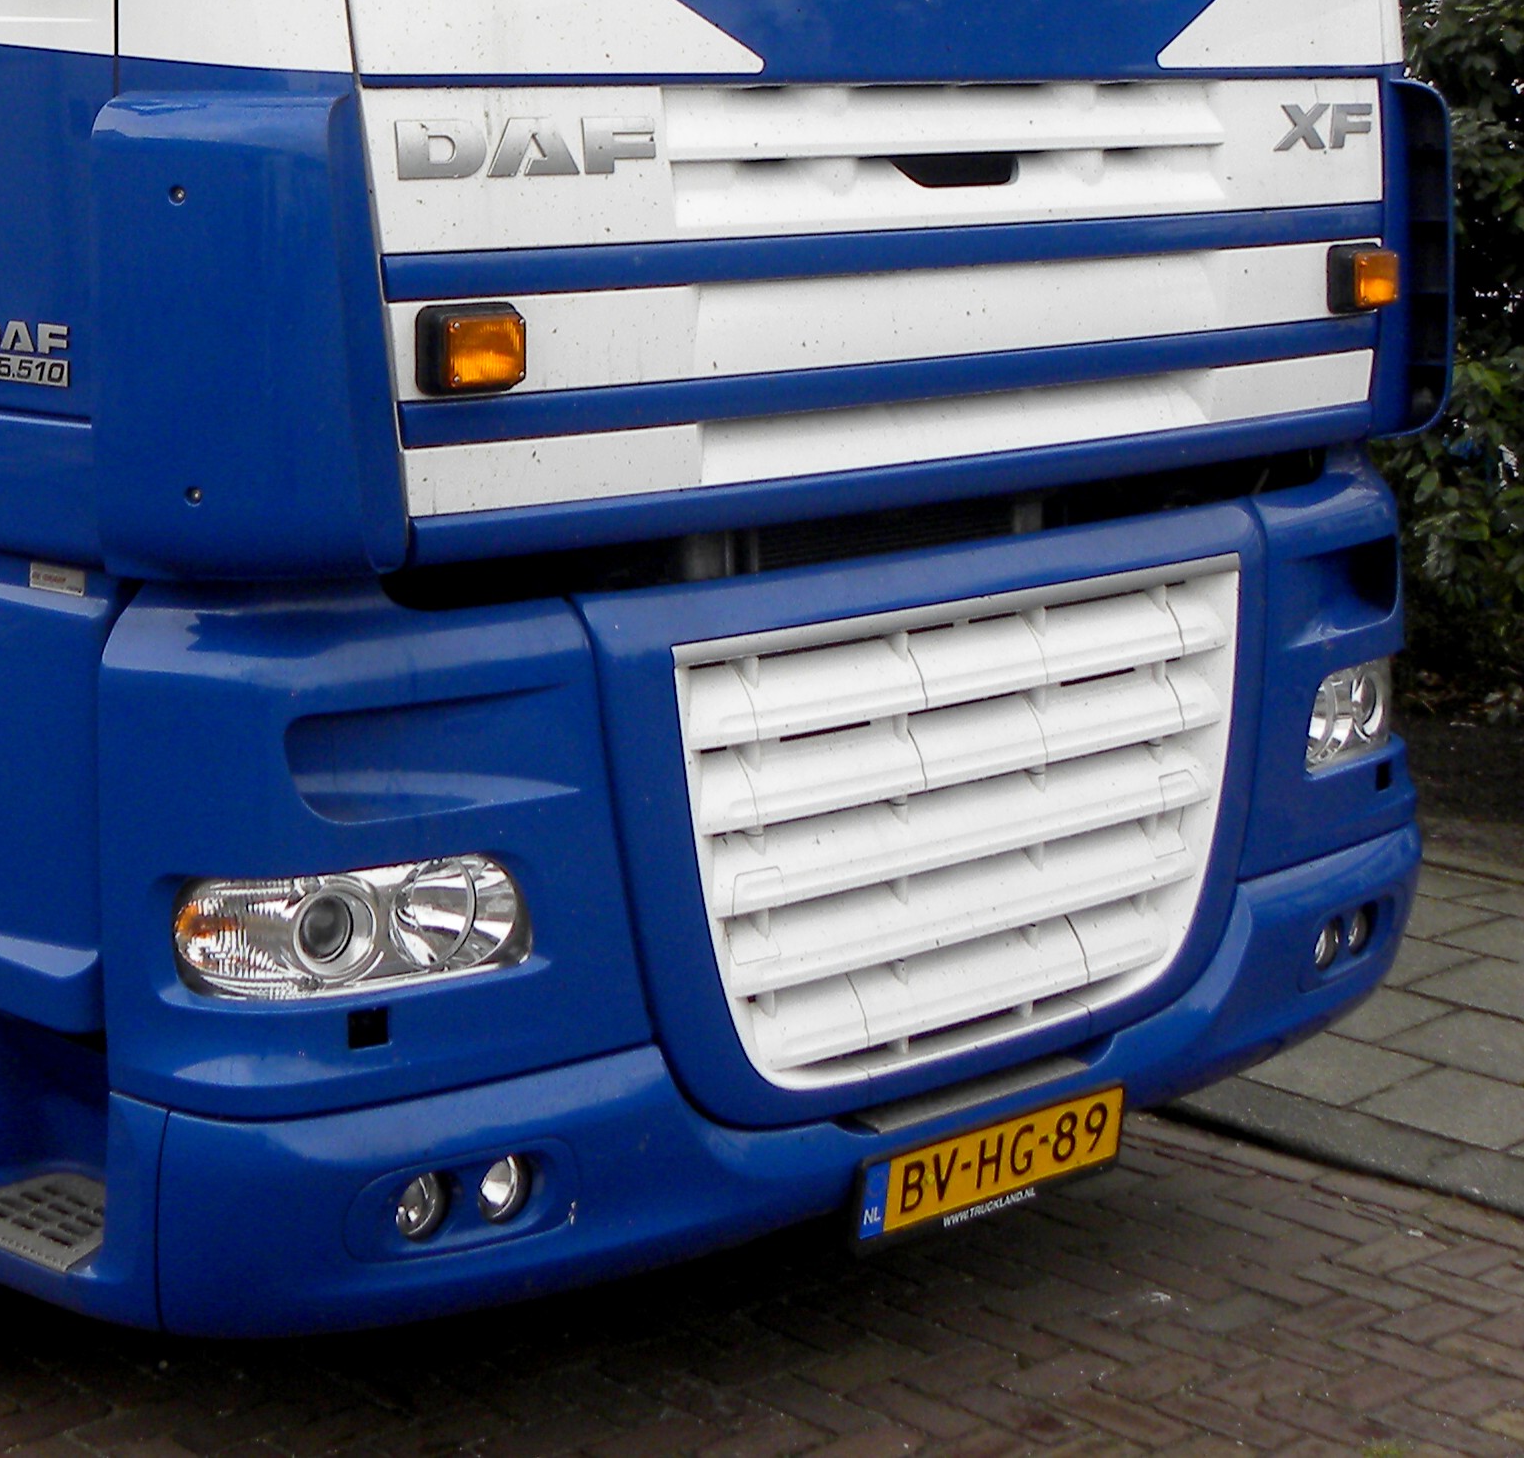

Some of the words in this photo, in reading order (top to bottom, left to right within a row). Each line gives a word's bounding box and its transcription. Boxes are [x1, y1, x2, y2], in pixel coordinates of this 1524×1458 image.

[394, 117, 656, 180] DAF
[1273, 103, 1372, 152] XF
[900, 1101, 1109, 1214] BV-HG-89
[863, 1206, 881, 1225] NL
[942, 1187, 1036, 1228] WWW.TRUCKLAND.NL
